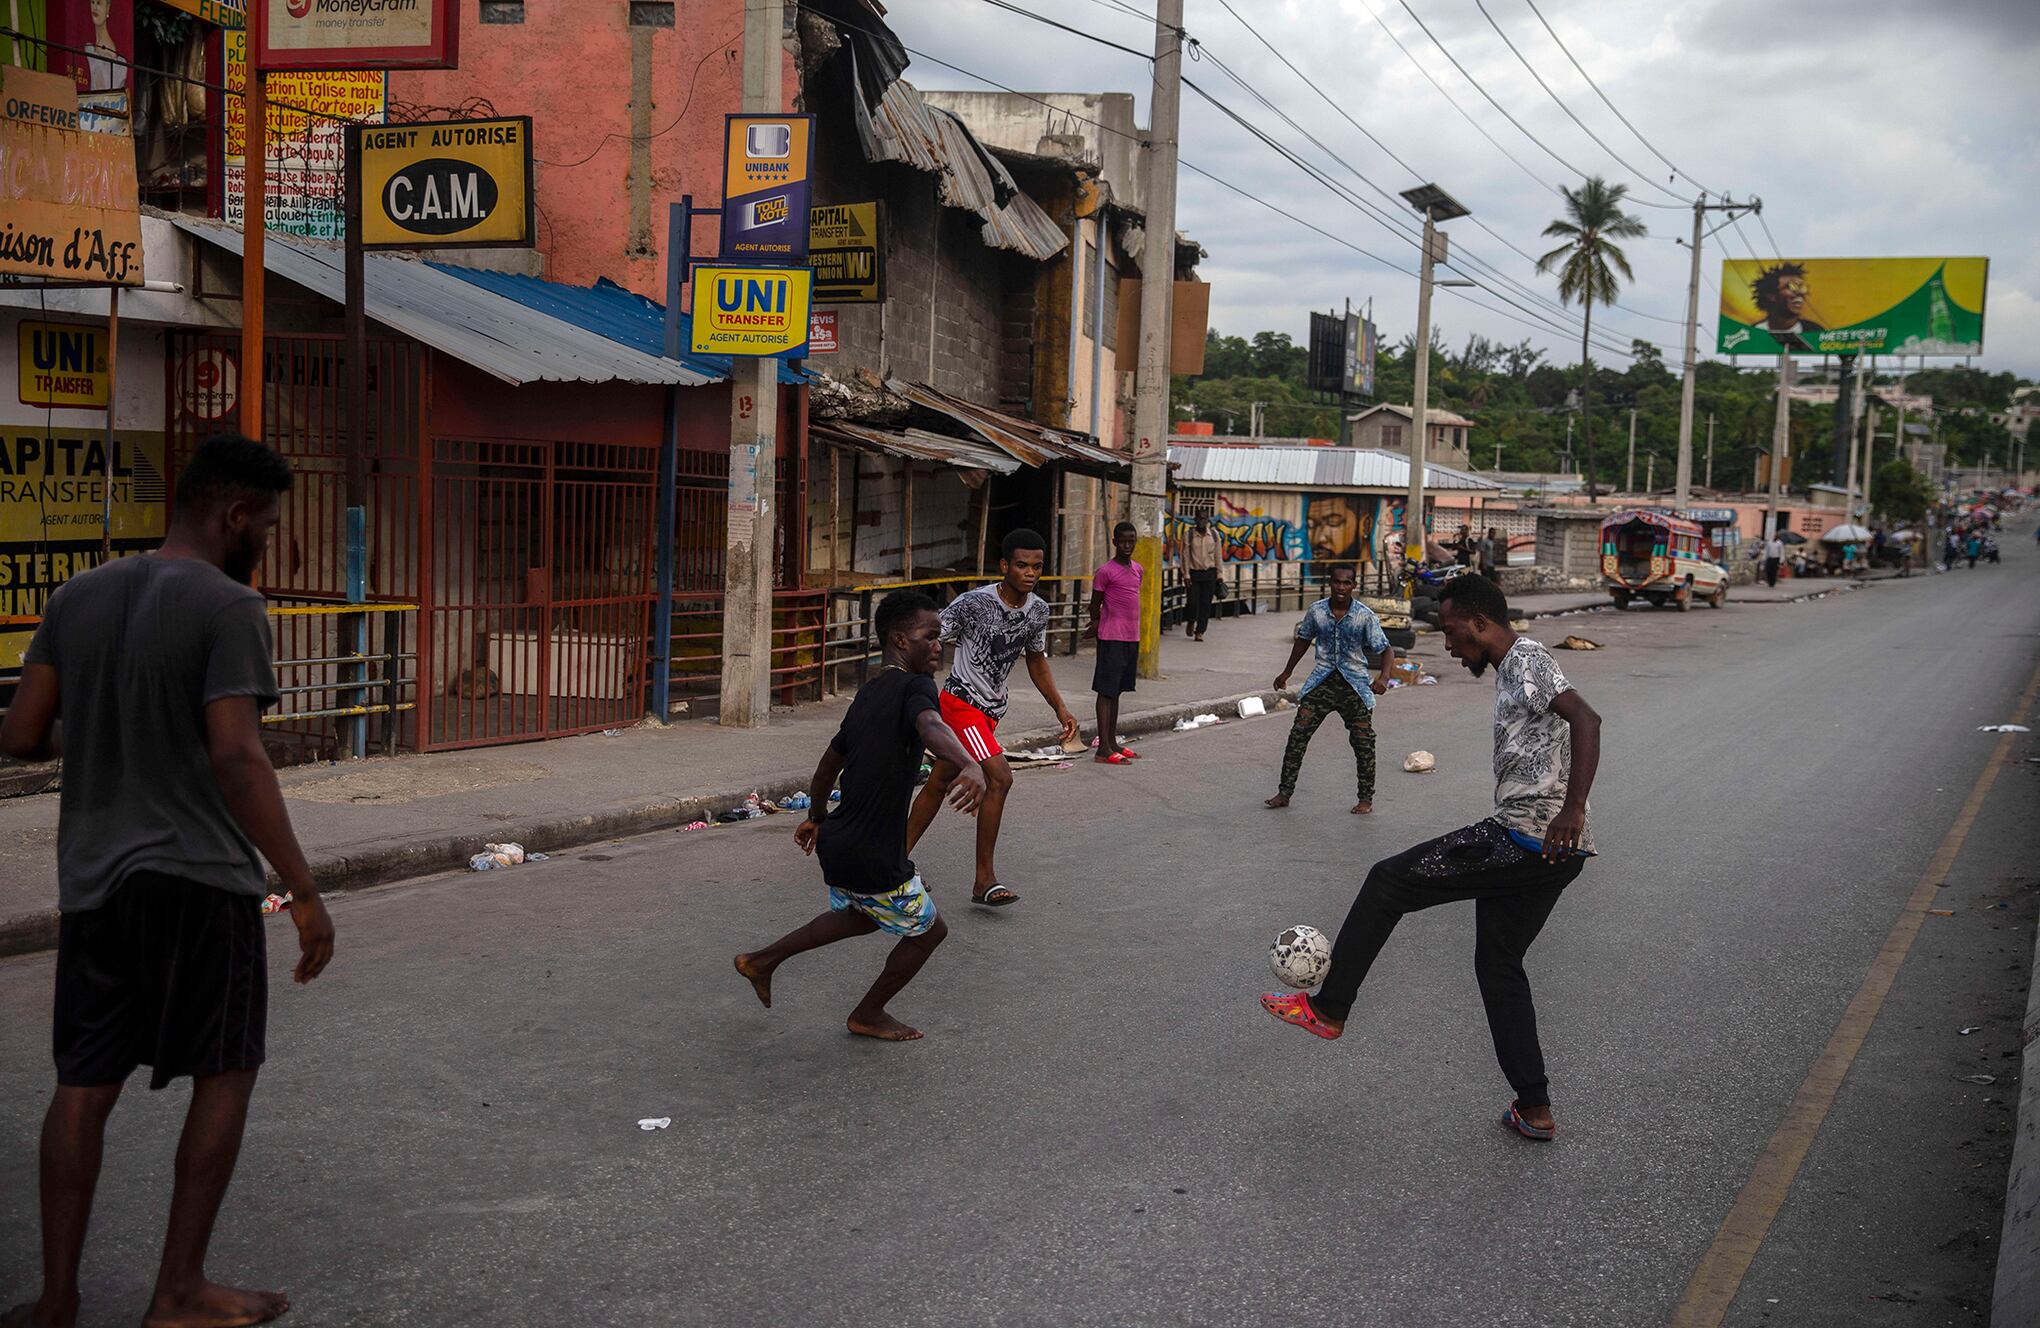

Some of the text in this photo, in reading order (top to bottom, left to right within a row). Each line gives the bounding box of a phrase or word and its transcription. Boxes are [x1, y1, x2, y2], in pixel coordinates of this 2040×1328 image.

[200, 0, 247, 27] FLEUR
[316, 0, 416, 16] MoneyGram
[316, 17, 386, 29] money transfer
[265, 80, 296, 95] ation
[6, 98, 77, 129] ORFEVRE
[365, 126, 517, 150] AGENT AUTORISE
[745, 163, 790, 172] UNIBANK
[389, 172, 486, 221] C.A.M.
[755, 198, 784, 215] TOUT
[759, 207, 789, 223] KOTE
[811, 207, 848, 227] APITAL
[811, 226, 848, 239] TRANSFERT
[735, 243, 792, 252] AGENT AUTORISE
[817, 266, 843, 280] UNION
[717, 278, 787, 313] UNI
[717, 314, 785, 326] TRANSFER
[709, 333, 789, 344] AGENT AUTORISÉ
[33, 330, 94, 373] UNI
[35, 375, 94, 396] TRANSFER
[739, 396, 753, 412] 13
[1139, 437, 1151, 449] 13
[0, 437, 133, 477] APITAL
[0, 480, 132, 503] RANSFERT
[40, 513, 104, 526] AGENT AUTOR
[0, 552, 91, 586] STERN
